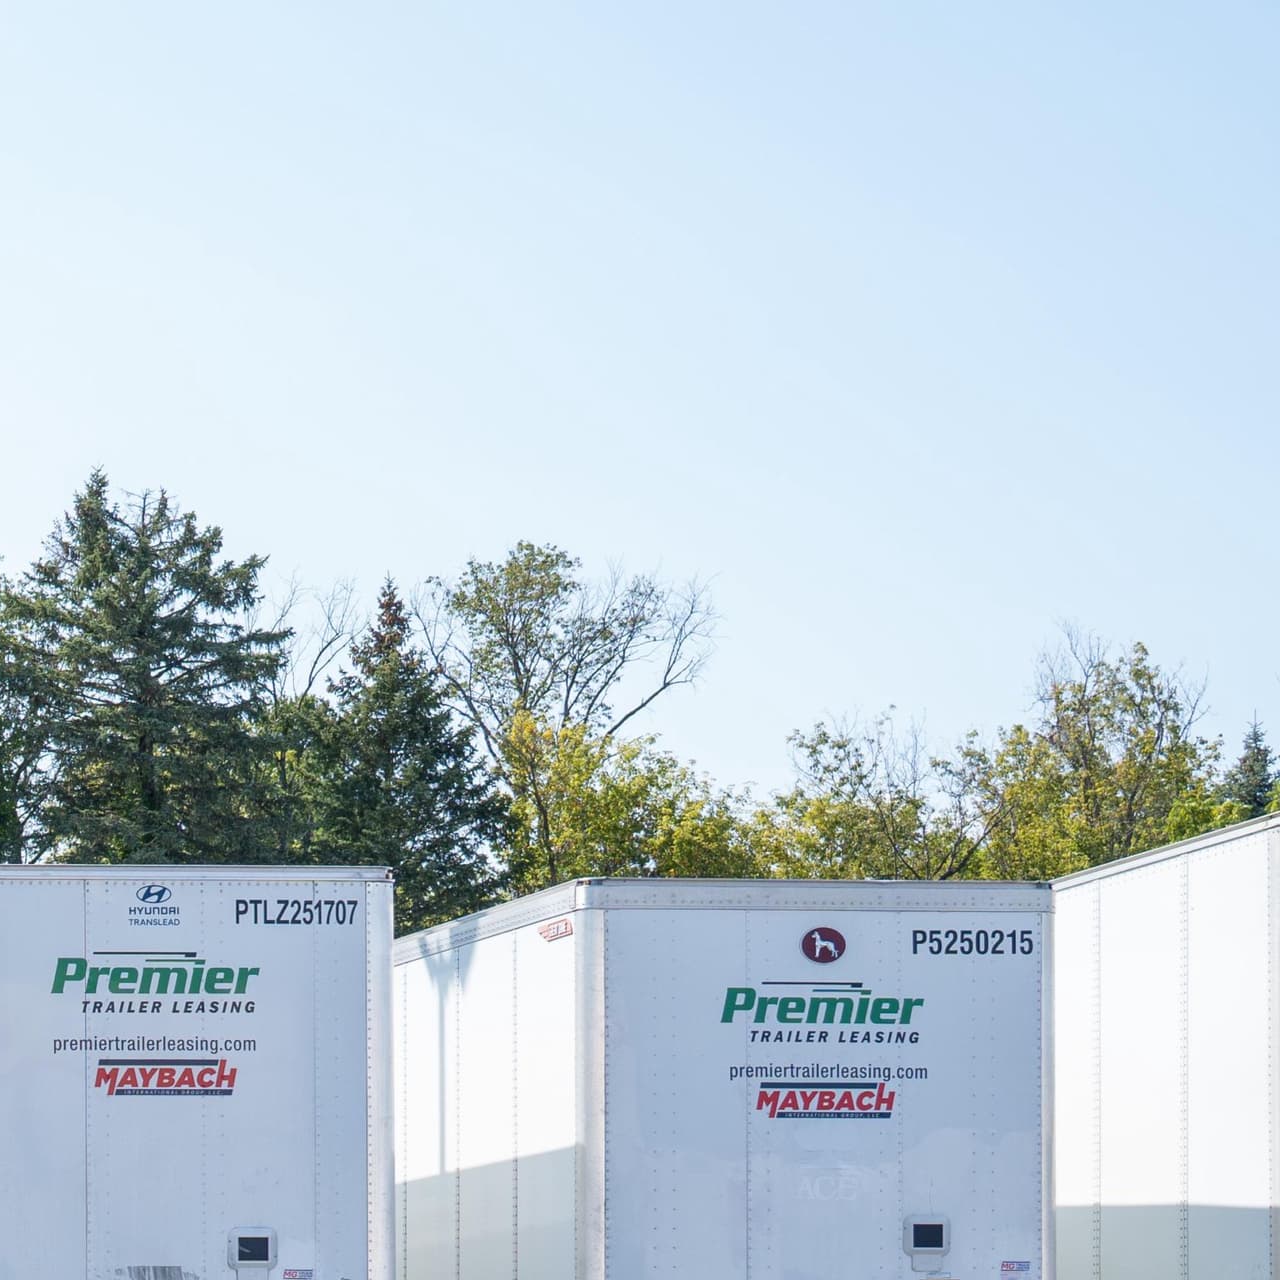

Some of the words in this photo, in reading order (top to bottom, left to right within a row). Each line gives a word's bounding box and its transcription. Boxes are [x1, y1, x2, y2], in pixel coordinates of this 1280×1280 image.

[128, 906, 180, 916] HYUNDAI
[129, 918, 181, 927] TRANSLEAD
[235, 899, 358, 926] PTLZ251707
[911, 929, 1034, 956] P5250215
[51, 956, 260, 995] Premier
[81, 1001, 163, 1014] TRAILER
[171, 1001, 257, 1014] LEASING
[720, 986, 925, 1025] Premier
[53, 1035, 257, 1054] premiertrailerleasing.com
[750, 1030, 829, 1043] TRAILER
[838, 1030, 921, 1044] LEASING
[94, 1058, 238, 1096] MAYBACH
[729, 1063, 928, 1082] premiertrailerleasing.com
[756, 1082, 896, 1118] MAYBACH
